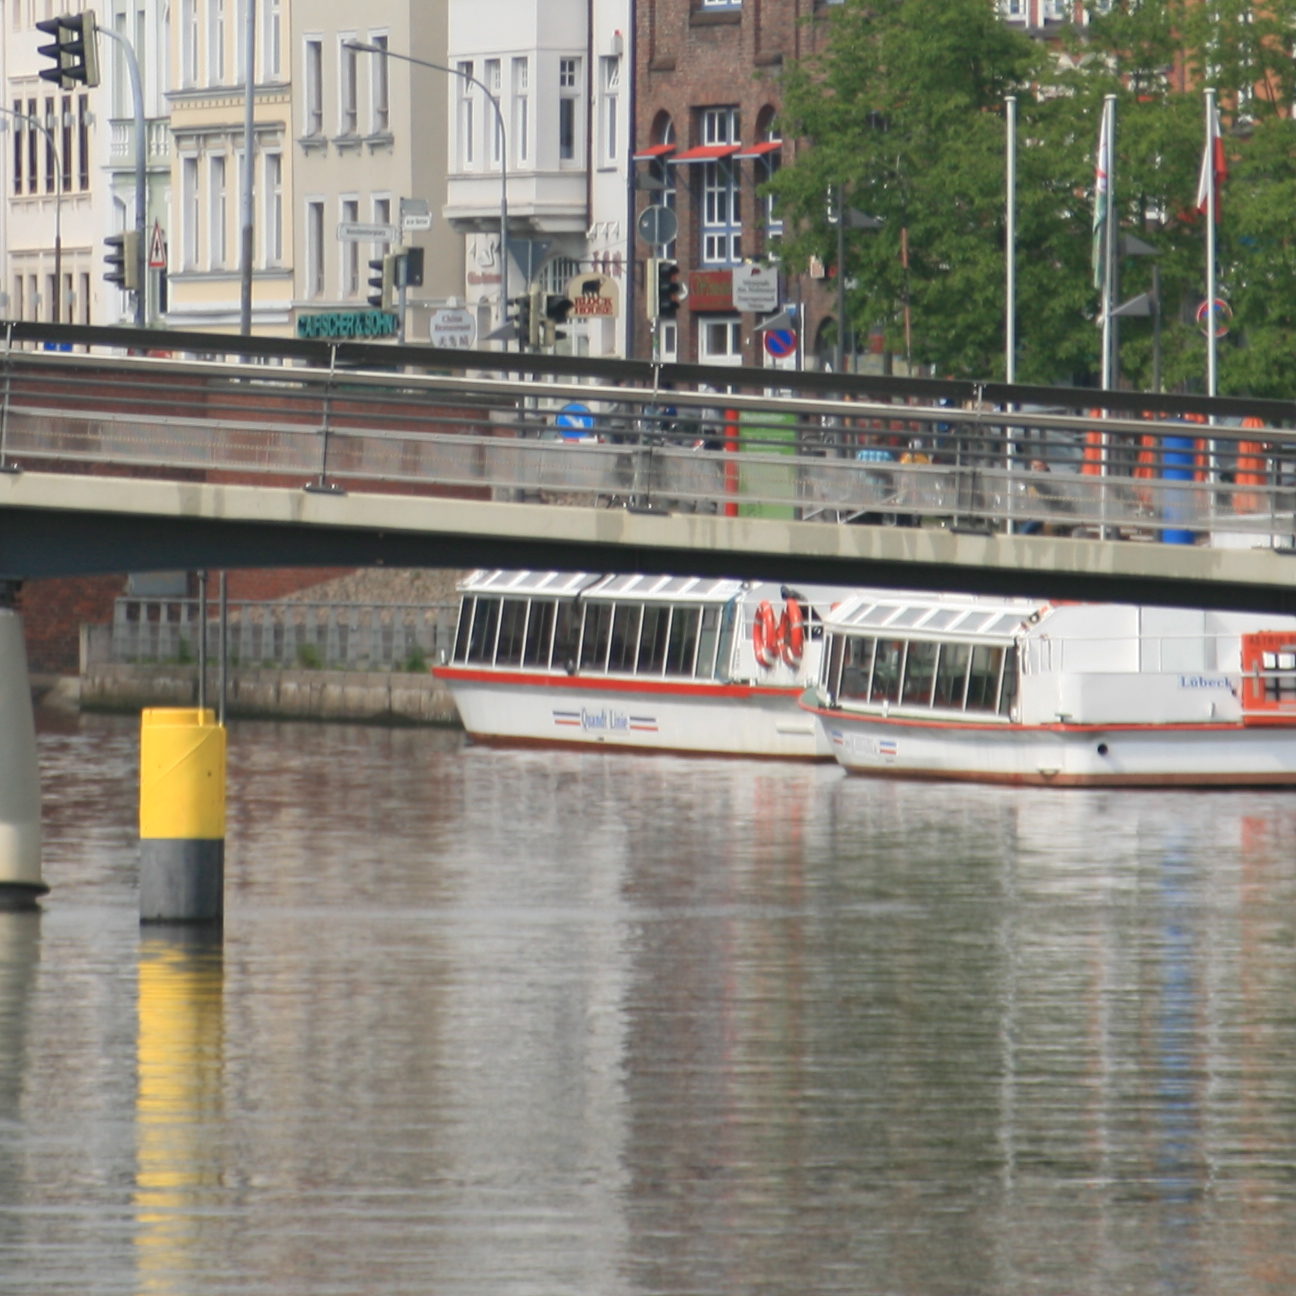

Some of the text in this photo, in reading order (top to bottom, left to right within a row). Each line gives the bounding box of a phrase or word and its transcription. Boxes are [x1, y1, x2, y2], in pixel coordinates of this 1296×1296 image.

[574, 297, 612, 306] BLOCK
[574, 306, 613, 315] HOUSE
[1180, 676, 1232, 688] Lübeck
[581, 707, 607, 732] Quandt
